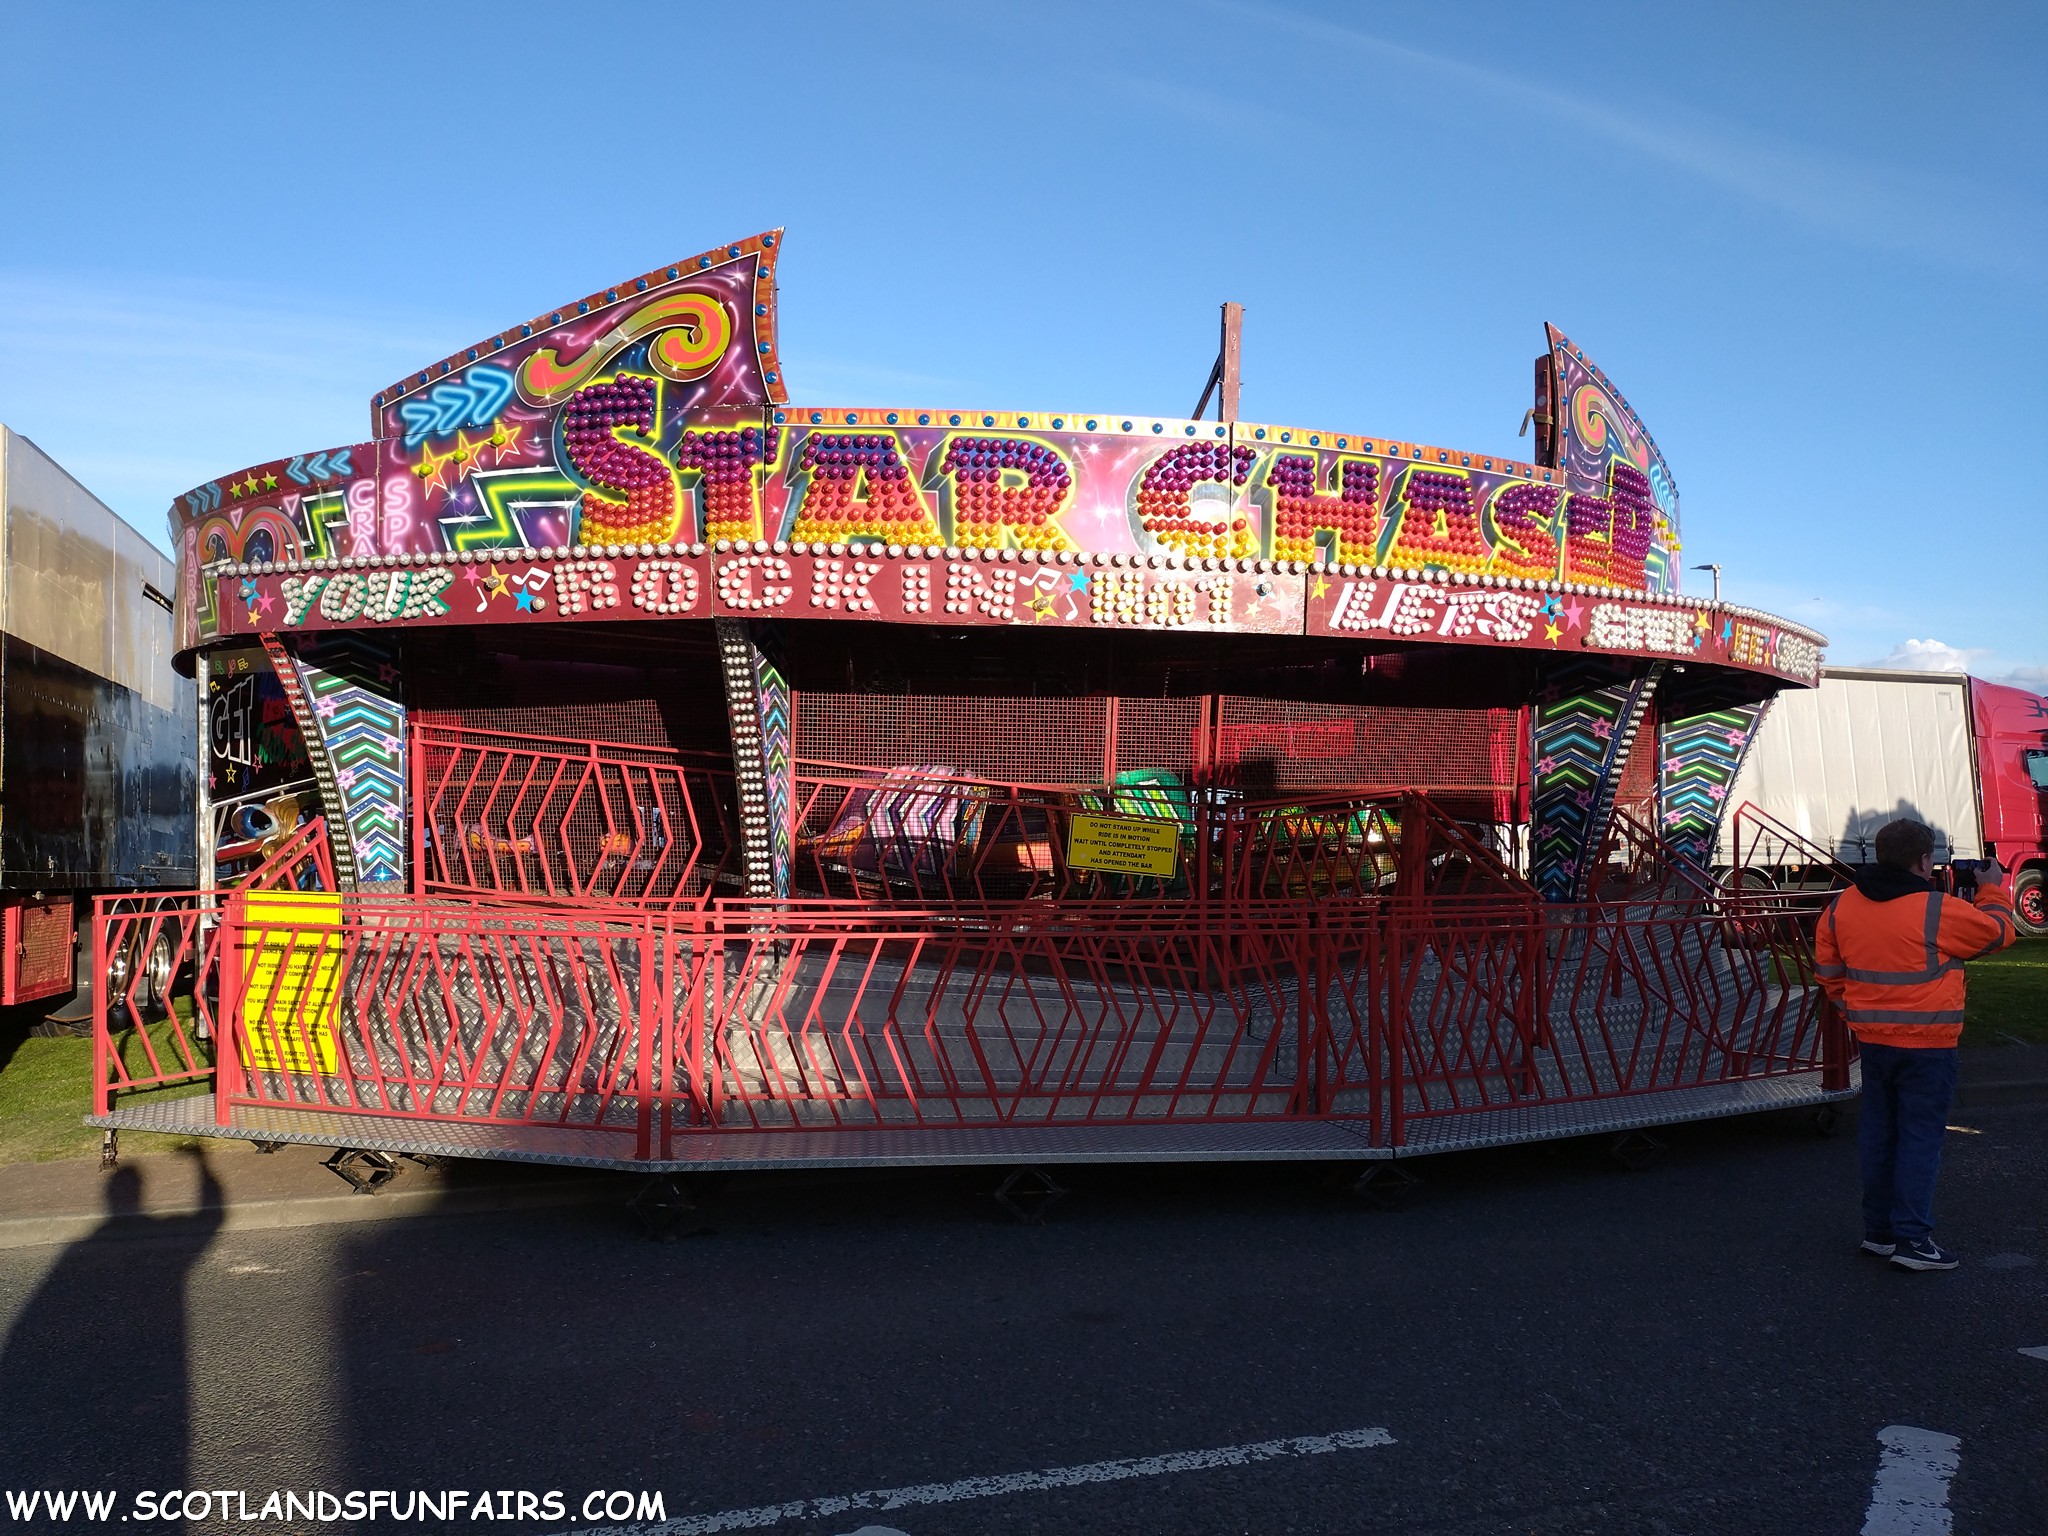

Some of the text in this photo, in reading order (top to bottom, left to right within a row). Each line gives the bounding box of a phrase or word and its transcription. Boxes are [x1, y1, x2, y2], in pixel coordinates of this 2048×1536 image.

[564, 373, 1652, 592] STAR CHASER
[185, 526, 199, 646] PARTY
[281, 566, 455, 625] YOUR
[552, 557, 1017, 619] ROCKIN
[1328, 582, 1540, 642] LETS
[210, 674, 255, 766] GET
[1103, 858, 1127, 866] OPENED
[1108, 842, 1145, 850] COMPLETELY
[1146, 845, 1172, 853] STOPPED
[1113, 851, 1146, 859] ATTENDANT
[1128, 834, 1150, 842] MOTION
